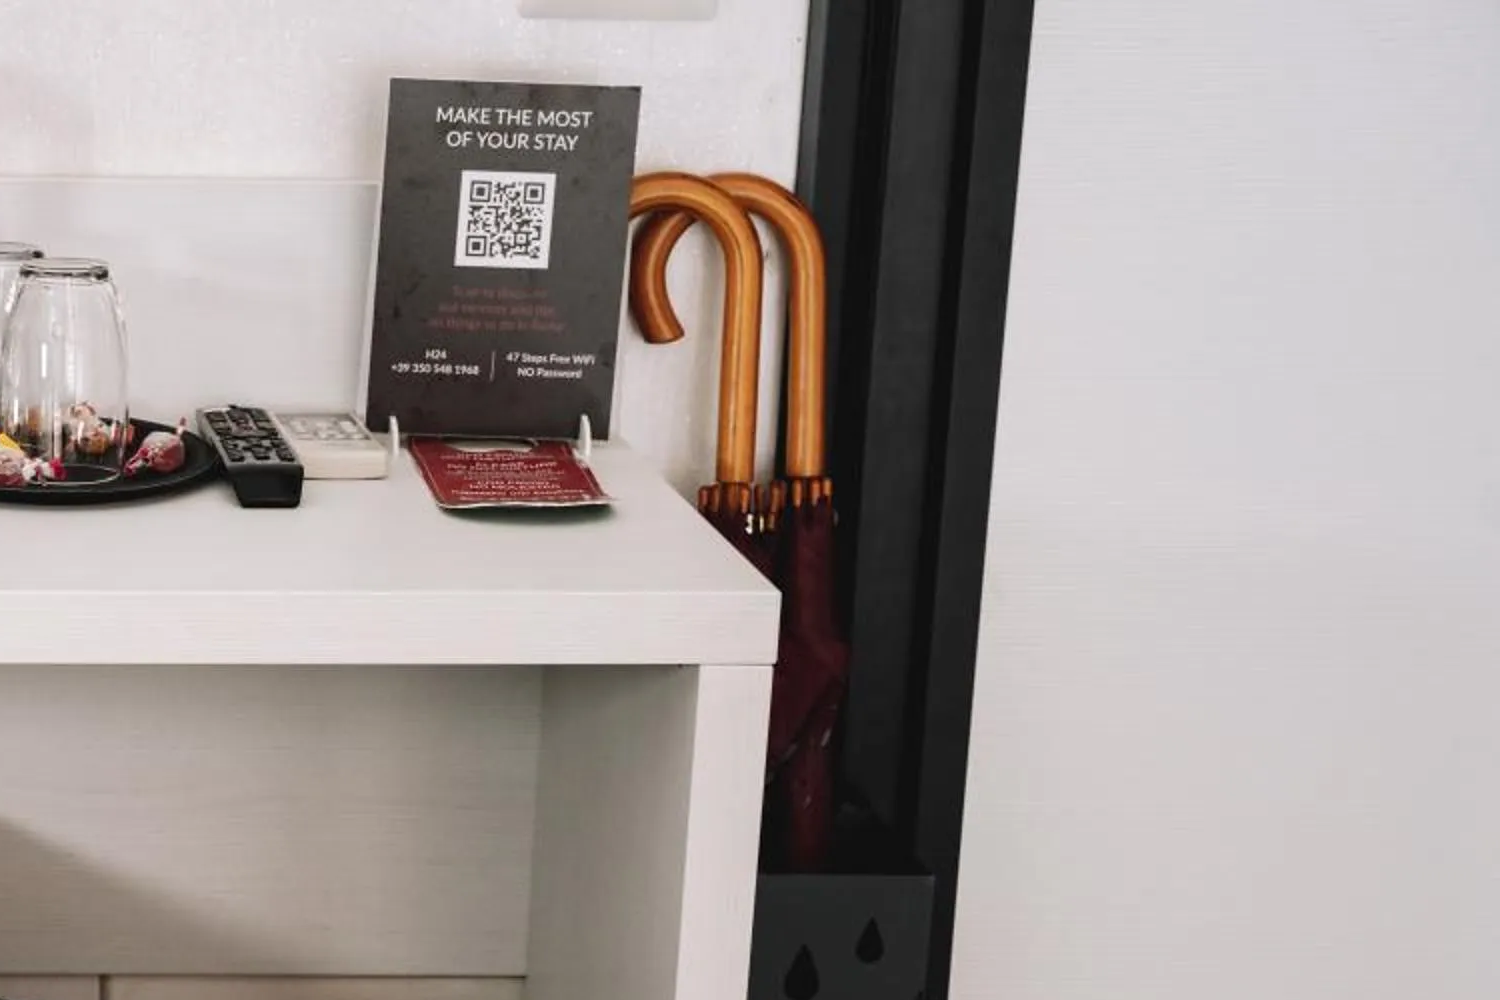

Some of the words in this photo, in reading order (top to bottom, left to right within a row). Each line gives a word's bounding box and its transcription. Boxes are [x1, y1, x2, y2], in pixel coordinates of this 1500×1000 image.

[435, 106, 491, 125] MAKE
[496, 108, 533, 127] THE
[537, 109, 593, 128] MOST
[446, 130, 473, 148] OF
[477, 131, 530, 150] YOUR
[533, 133, 579, 152] STAY
[522, 353, 549, 366] Steps
[549, 354, 571, 366] Free
[517, 367, 535, 379] NO
[537, 368, 583, 381] Password
